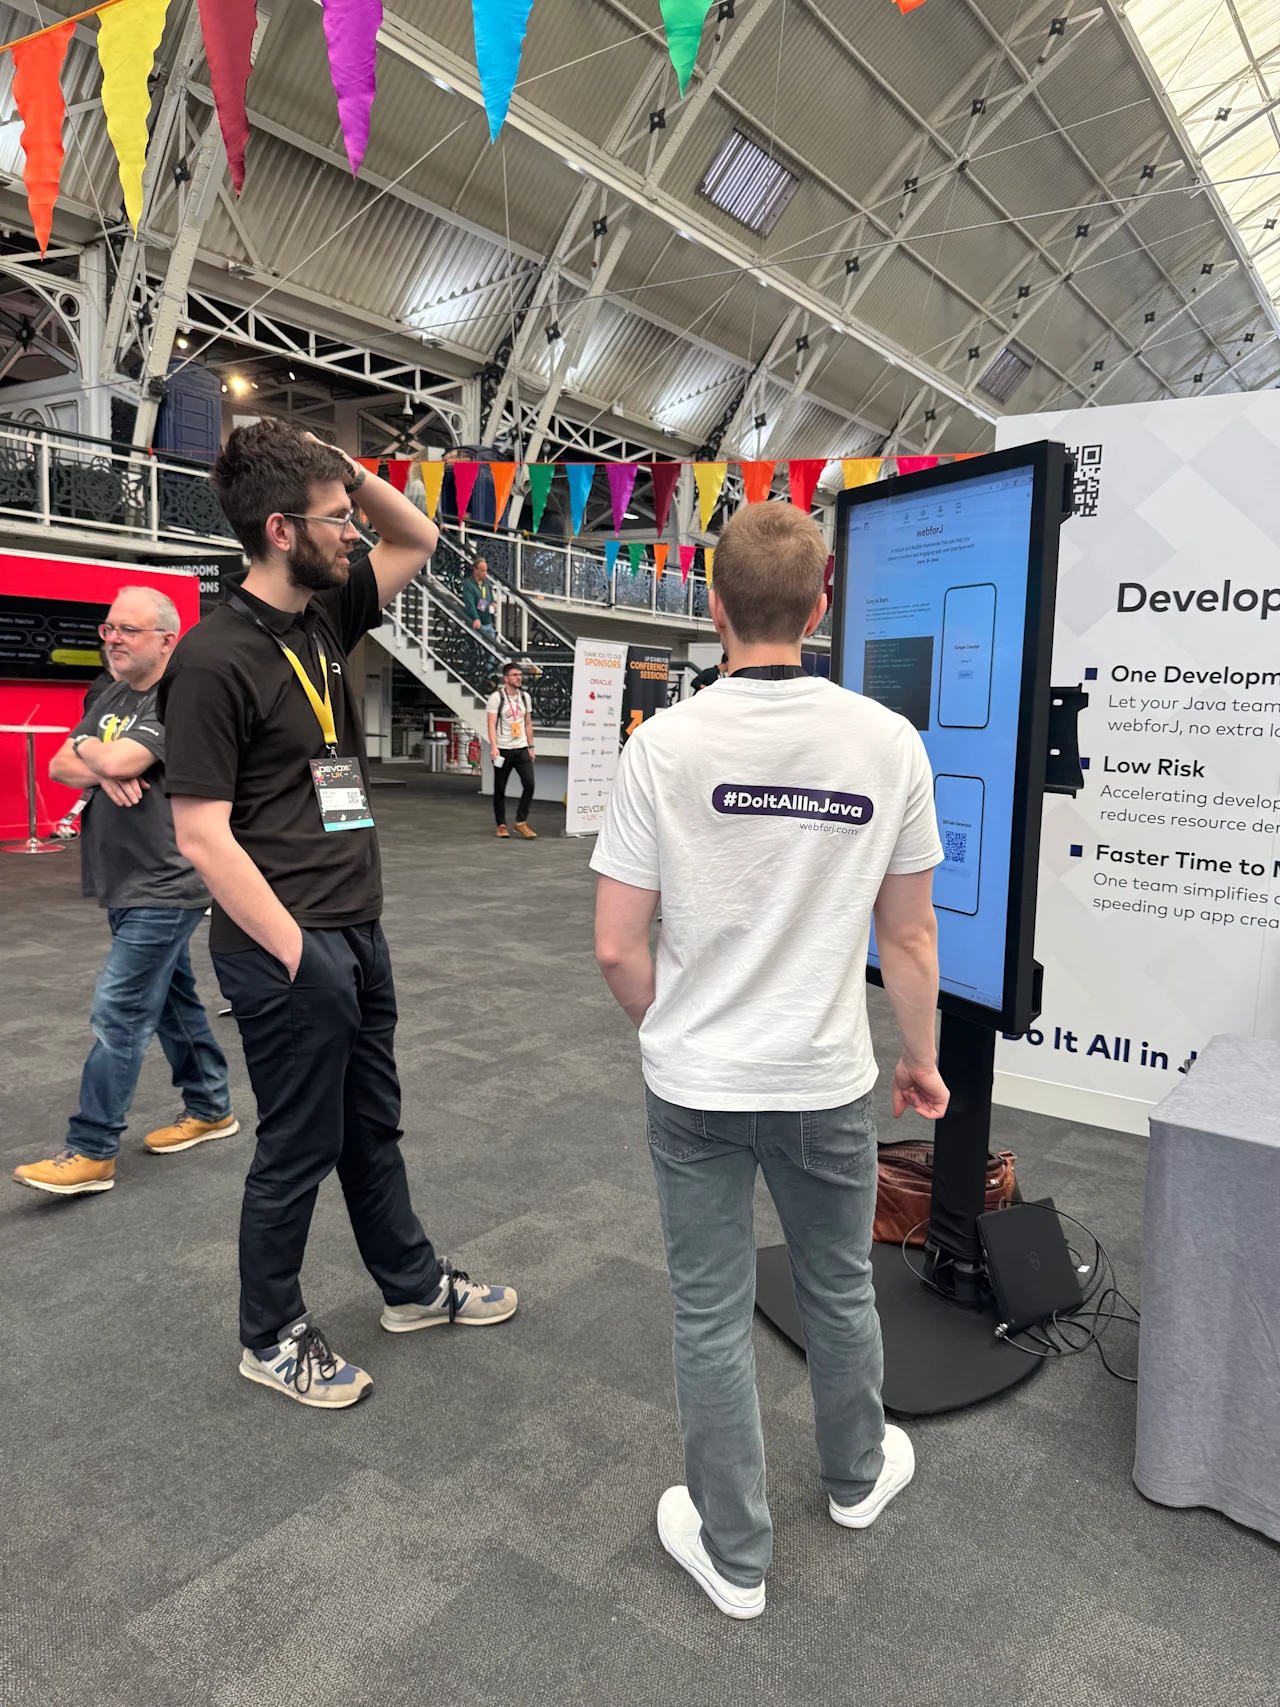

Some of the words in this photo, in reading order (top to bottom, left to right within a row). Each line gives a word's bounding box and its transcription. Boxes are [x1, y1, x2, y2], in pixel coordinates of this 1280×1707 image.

[917, 524, 944, 537] webforJ
[162, 564, 219, 577] ROOMS
[1117, 579, 1280, 620] Develop
[584, 657, 622, 669] SPONSORS
[629, 661, 669, 672] CONFERENCE
[589, 678, 613, 686] ORACLE
[640, 671, 668, 680] SESSIONS
[1111, 665, 1157, 683] One
[1164, 666, 1280, 690] Developm
[1108, 694, 1136, 709] Let
[1140, 699, 1179, 712] your
[1183, 697, 1227, 712] Java
[1232, 699, 1280, 713] team
[1107, 718, 1183, 737] webforJ,
[1189, 724, 1211, 735] no
[1216, 723, 1264, 738] extra
[1103, 755, 1151, 774] Low
[1157, 758, 1206, 778] Risk
[576, 804, 606, 814] DEVOX
[723, 791, 863, 818] #DoItAllInJava
[1100, 784, 1208, 808] Accelerating
[1213, 792, 1280, 813] develop
[799, 822, 858, 836] webforj.com
[1100, 808, 1166, 825] reduces
[1171, 815, 1247, 832] resource
[1096, 844, 1170, 867] Faster
[1175, 851, 1232, 874] Time
[1238, 859, 1265, 876] to
[1093, 872, 1128, 888] One
[1132, 877, 1178, 894] team
[1183, 882, 1268, 904] simplifies
[1092, 897, 1168, 919] speeding
[1173, 907, 1195, 921] up
[1200, 910, 1235, 926] app
[1239, 914, 1280, 930] crea
[1054, 1026, 1078, 1053] It
[1086, 1034, 1131, 1063] All
[1140, 1041, 1168, 1070] in
